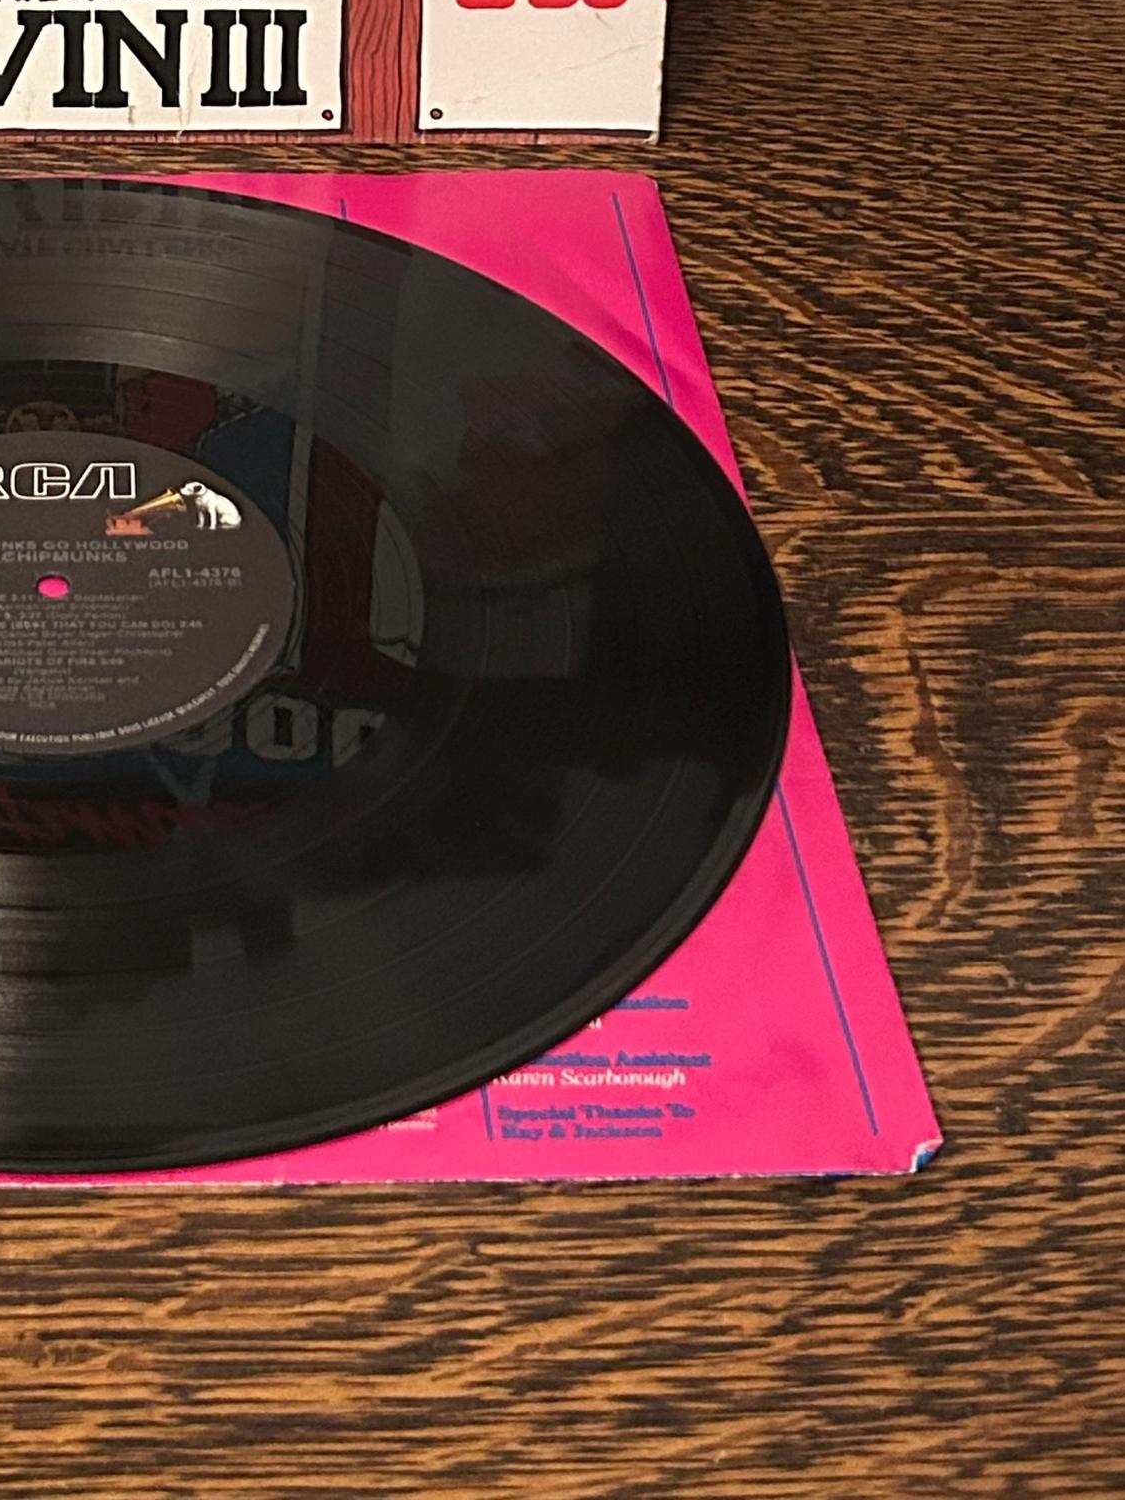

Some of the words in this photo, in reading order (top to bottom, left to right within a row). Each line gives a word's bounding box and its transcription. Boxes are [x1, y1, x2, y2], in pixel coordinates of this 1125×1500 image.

[200, 9, 307, 107] III
[42, 539, 70, 551] GO
[75, 539, 190, 551] HOLLYWOOD
[0, 550, 128, 563] CHIPMUNKS
[560, 1067, 687, 1089] Scarborough
